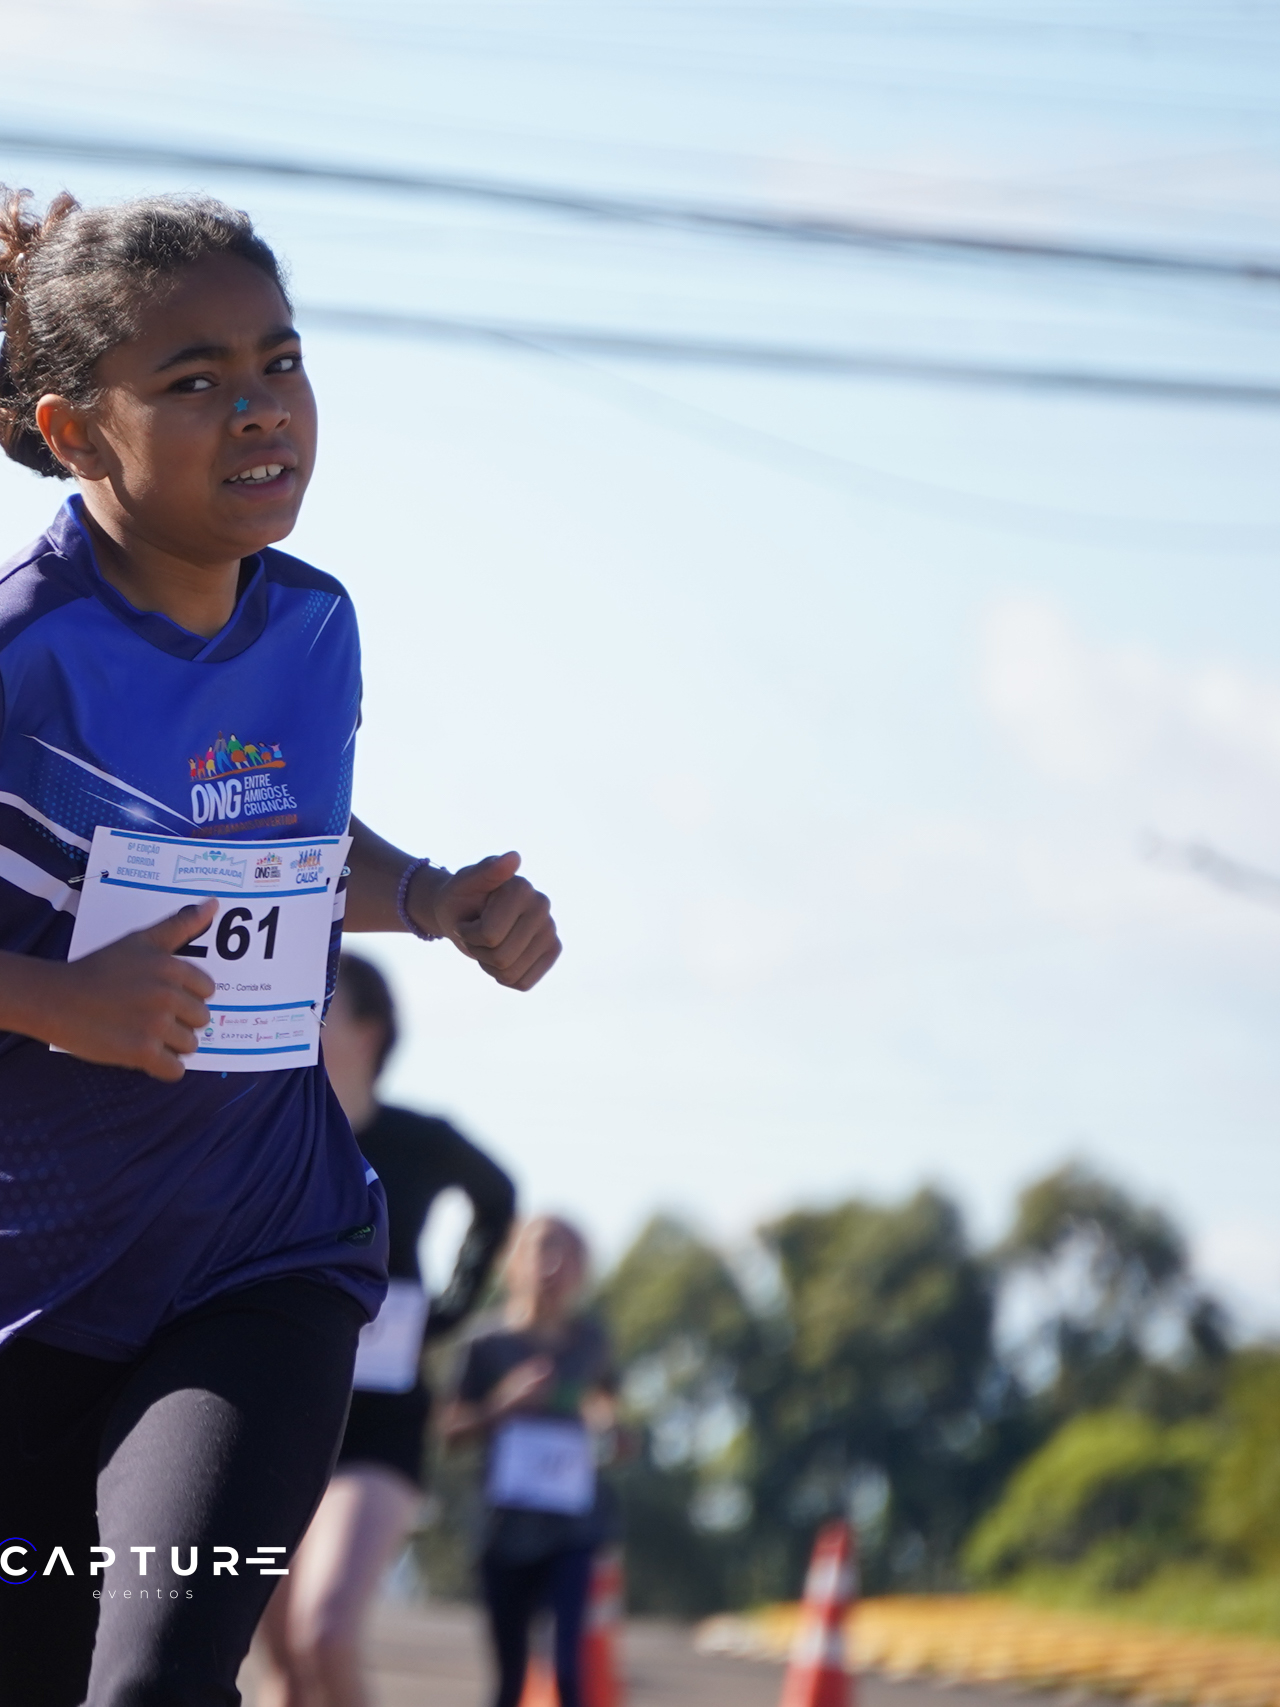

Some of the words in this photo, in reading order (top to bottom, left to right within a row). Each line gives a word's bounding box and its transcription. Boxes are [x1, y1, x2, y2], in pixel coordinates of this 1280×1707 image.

[244, 774, 272, 789] ENTRE
[191, 779, 242, 824] ONG
[244, 785, 282, 803] AMIGOS
[127, 855, 155, 867] CORRIDA
[116, 866, 161, 881] BENEFICENTE
[178, 867, 219, 876] PRATIQUE
[218, 868, 242, 878] AJUDA
[255, 866, 271, 879] ONG
[296, 871, 319, 885] CAUSA
[172, 904, 280, 961] 261
